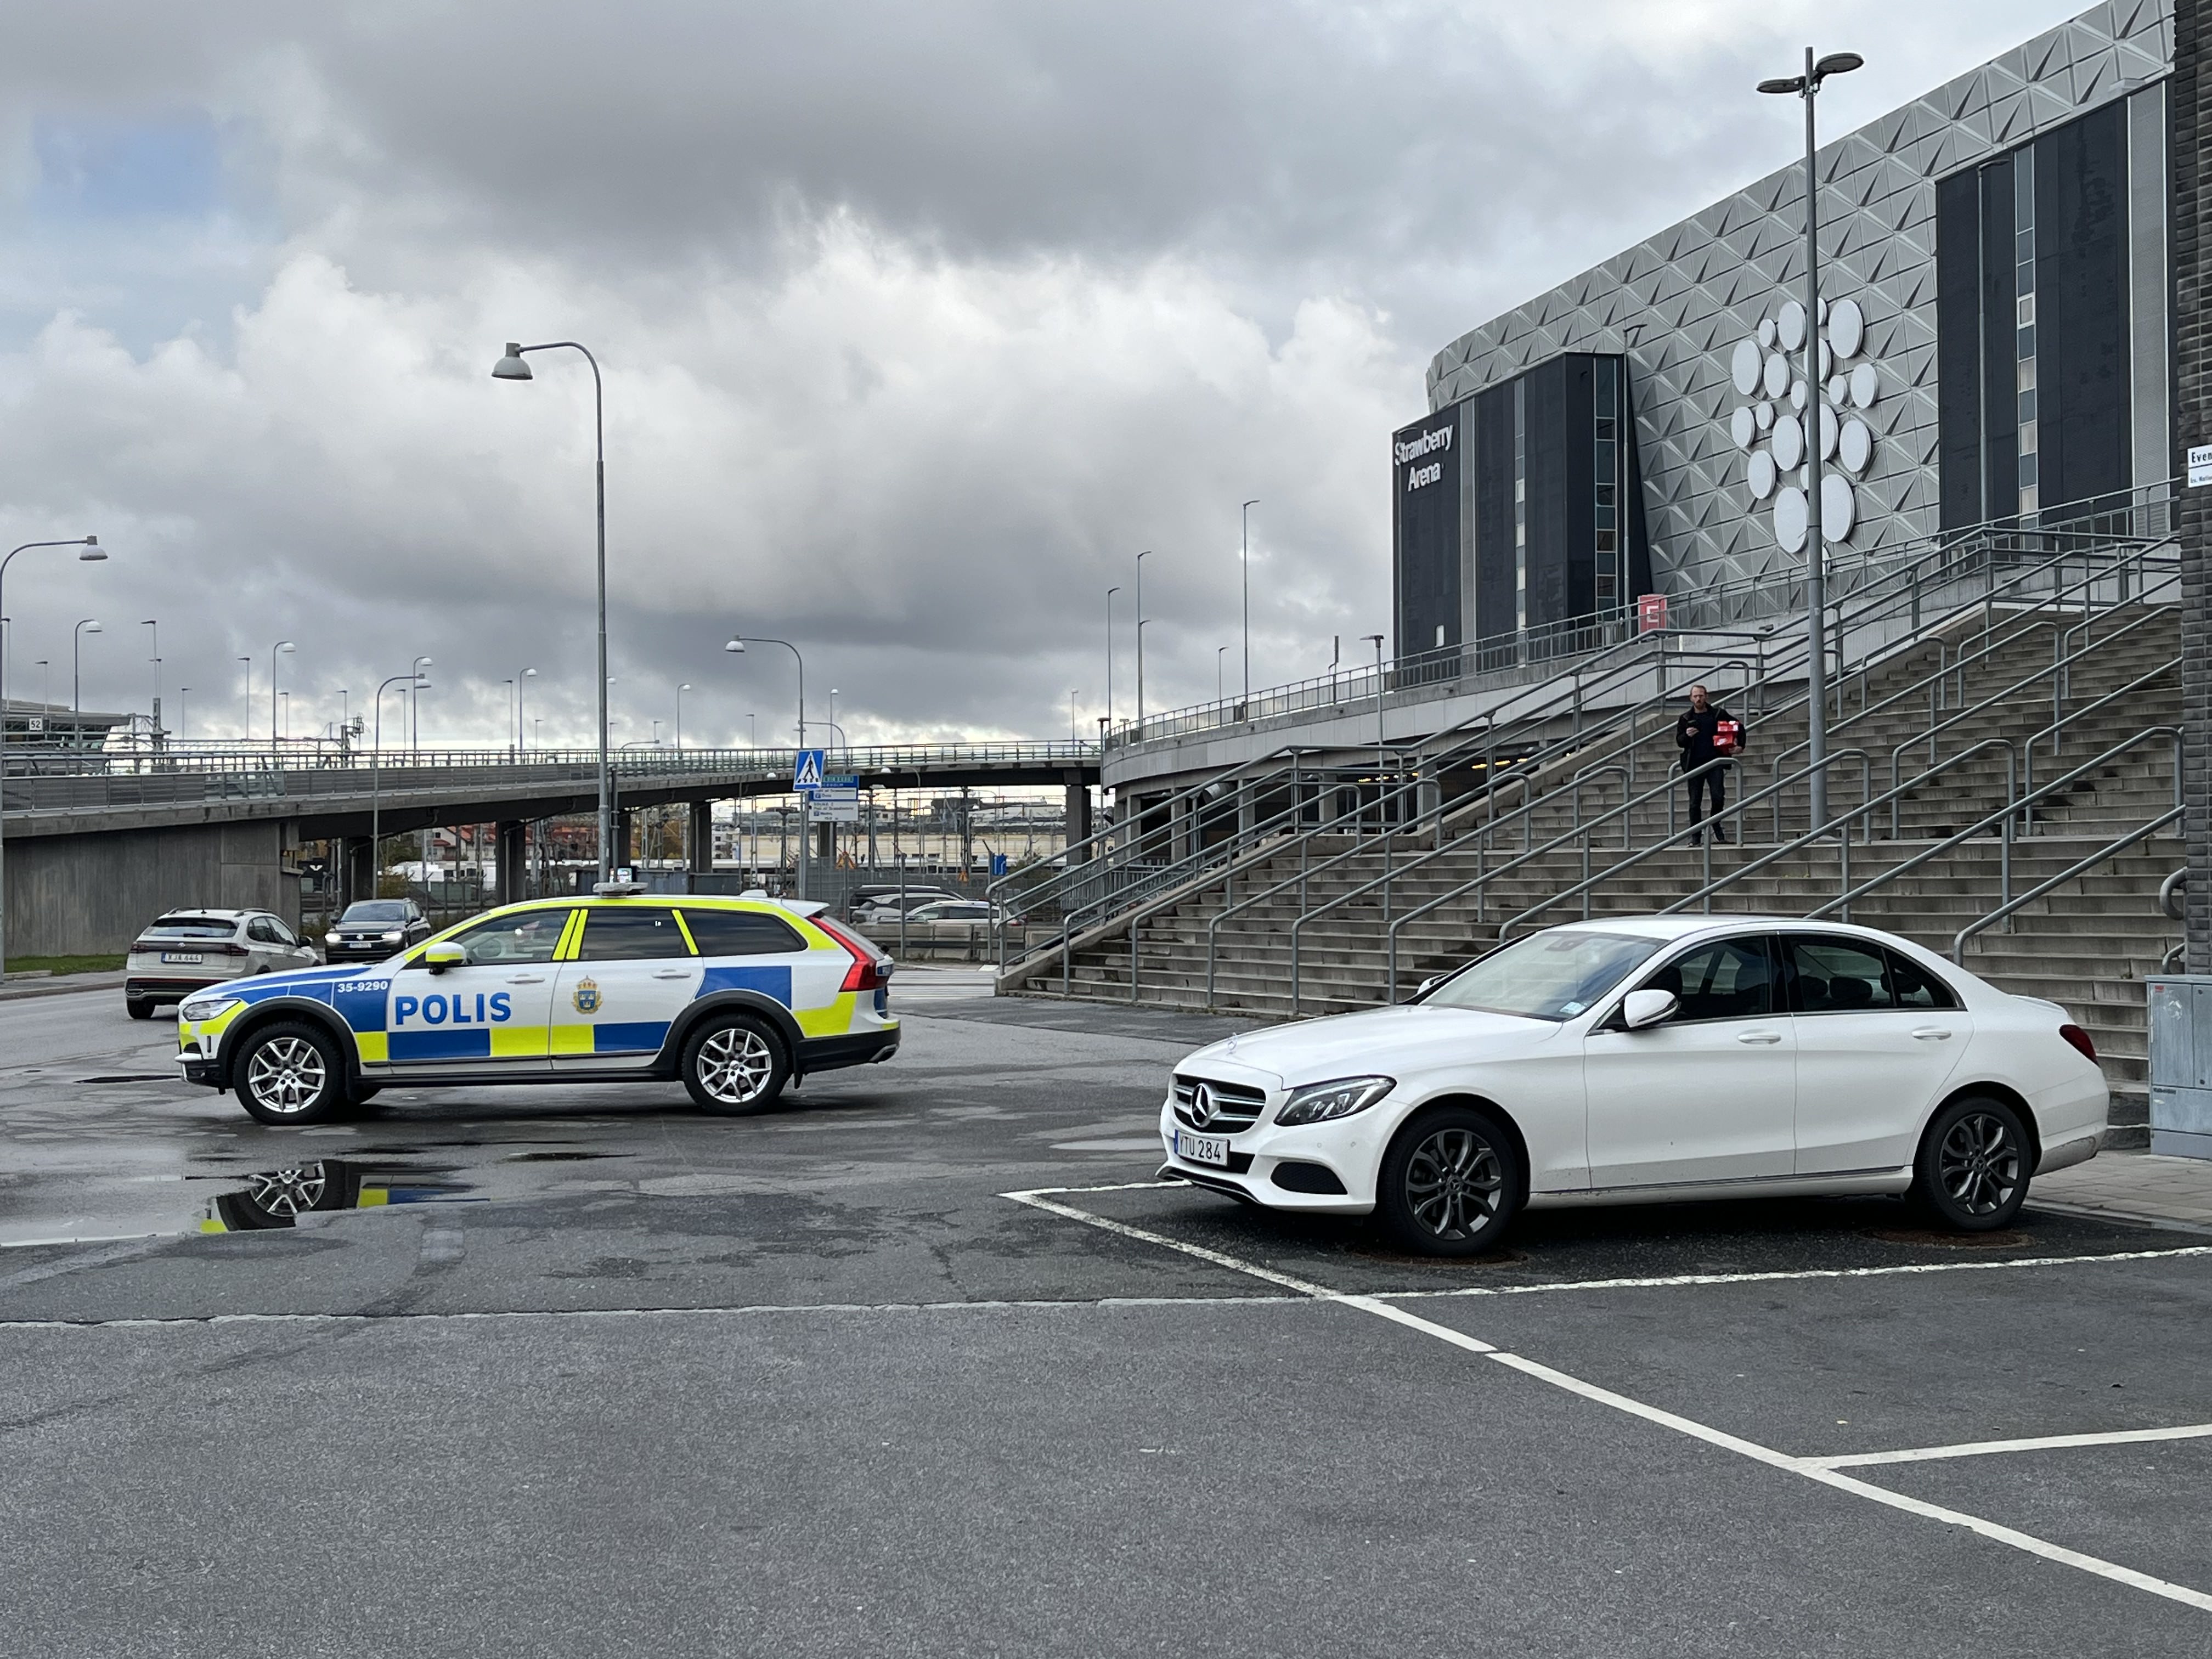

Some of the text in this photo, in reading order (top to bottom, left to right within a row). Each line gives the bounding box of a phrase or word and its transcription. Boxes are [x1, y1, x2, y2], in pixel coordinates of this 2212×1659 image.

[1395, 424, 1453, 466] Strawberry
[1408, 462, 1441, 492] Arena
[31, 720, 41, 729] 52
[337, 980, 388, 993] 35-9290
[395, 992, 511, 1025] POLIS
[1180, 1133, 1221, 1161] YTU 284
